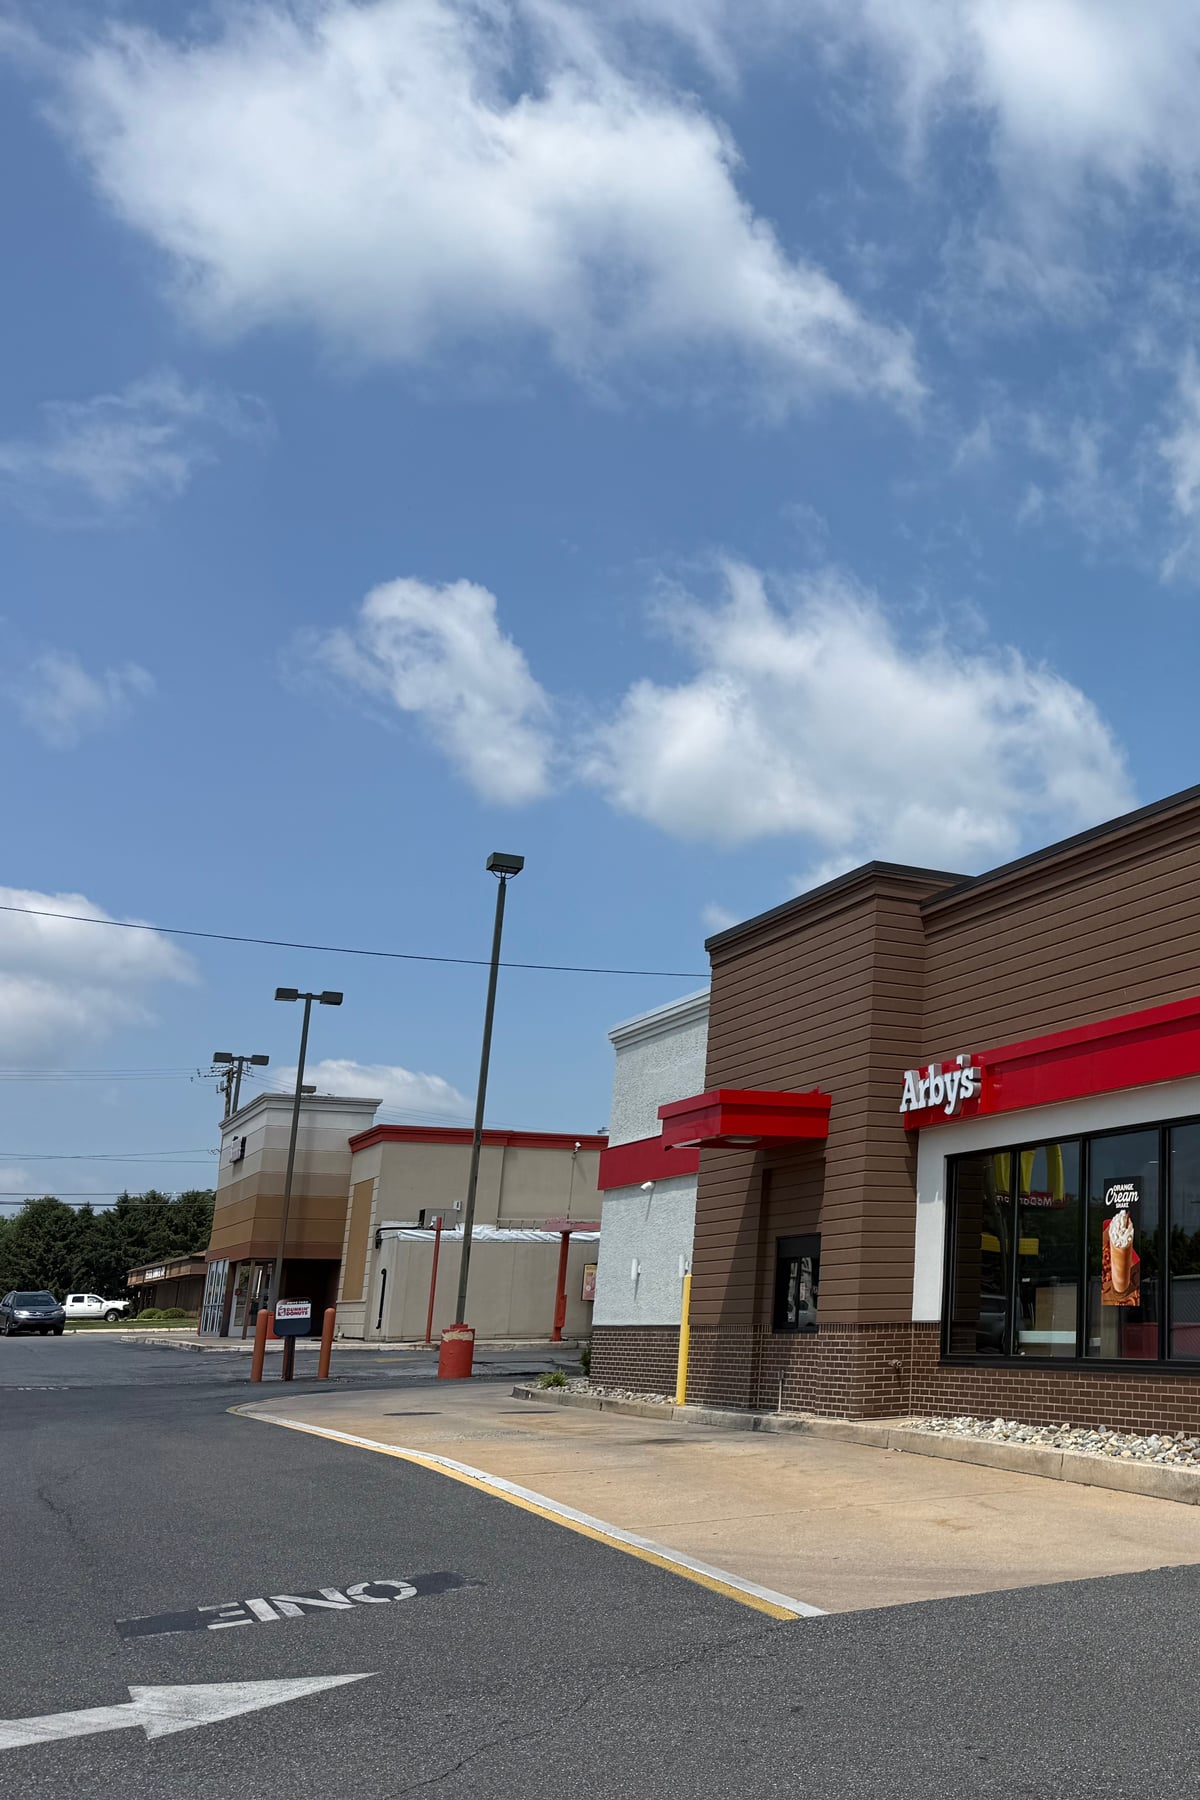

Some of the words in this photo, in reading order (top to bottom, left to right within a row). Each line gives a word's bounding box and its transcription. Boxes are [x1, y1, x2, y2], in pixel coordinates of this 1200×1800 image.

[900, 1054, 980, 1115] Arby's
[1105, 1188, 1139, 1205] Cream
[1113, 1183, 1134, 1191] ORANGE
[198, 1579, 418, 1630] ONE
